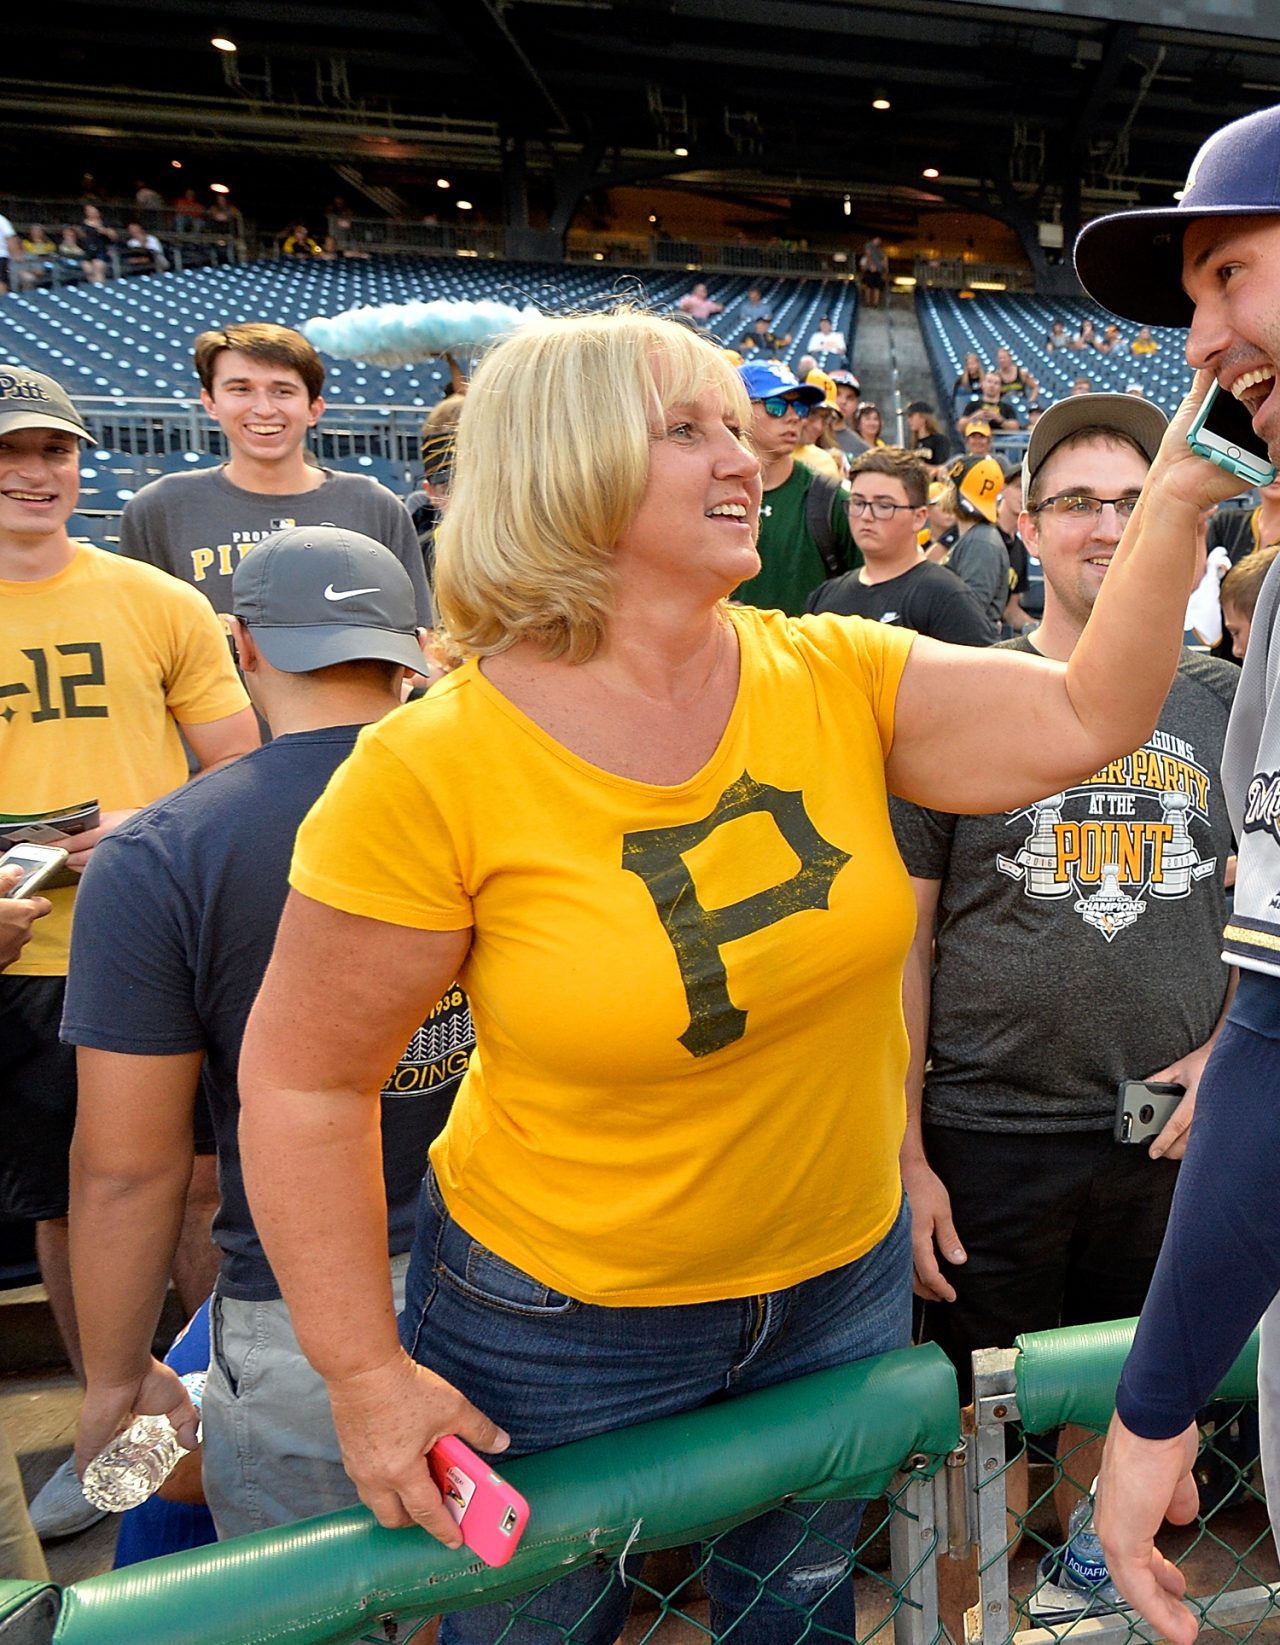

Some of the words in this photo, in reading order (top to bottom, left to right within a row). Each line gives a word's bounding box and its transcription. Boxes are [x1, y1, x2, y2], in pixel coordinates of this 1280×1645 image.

[0, 375, 49, 401] Pitt
[0, 642, 109, 723] 12
[1145, 729, 1196, 763] GUINS
[1131, 749, 1208, 811] PARTY
[1088, 794, 1106, 815] AT
[1107, 795, 1136, 815] THE
[1025, 856, 1053, 867] 2016
[1053, 821, 1174, 883] POINT
[1167, 855, 1191, 867] 2017
[621, 768, 853, 1058] P
[1076, 901, 1145, 912] CHAMPIONS
[429, 991, 463, 1020] 1938
[1068, 1557, 1109, 1577] AQUAFIN
